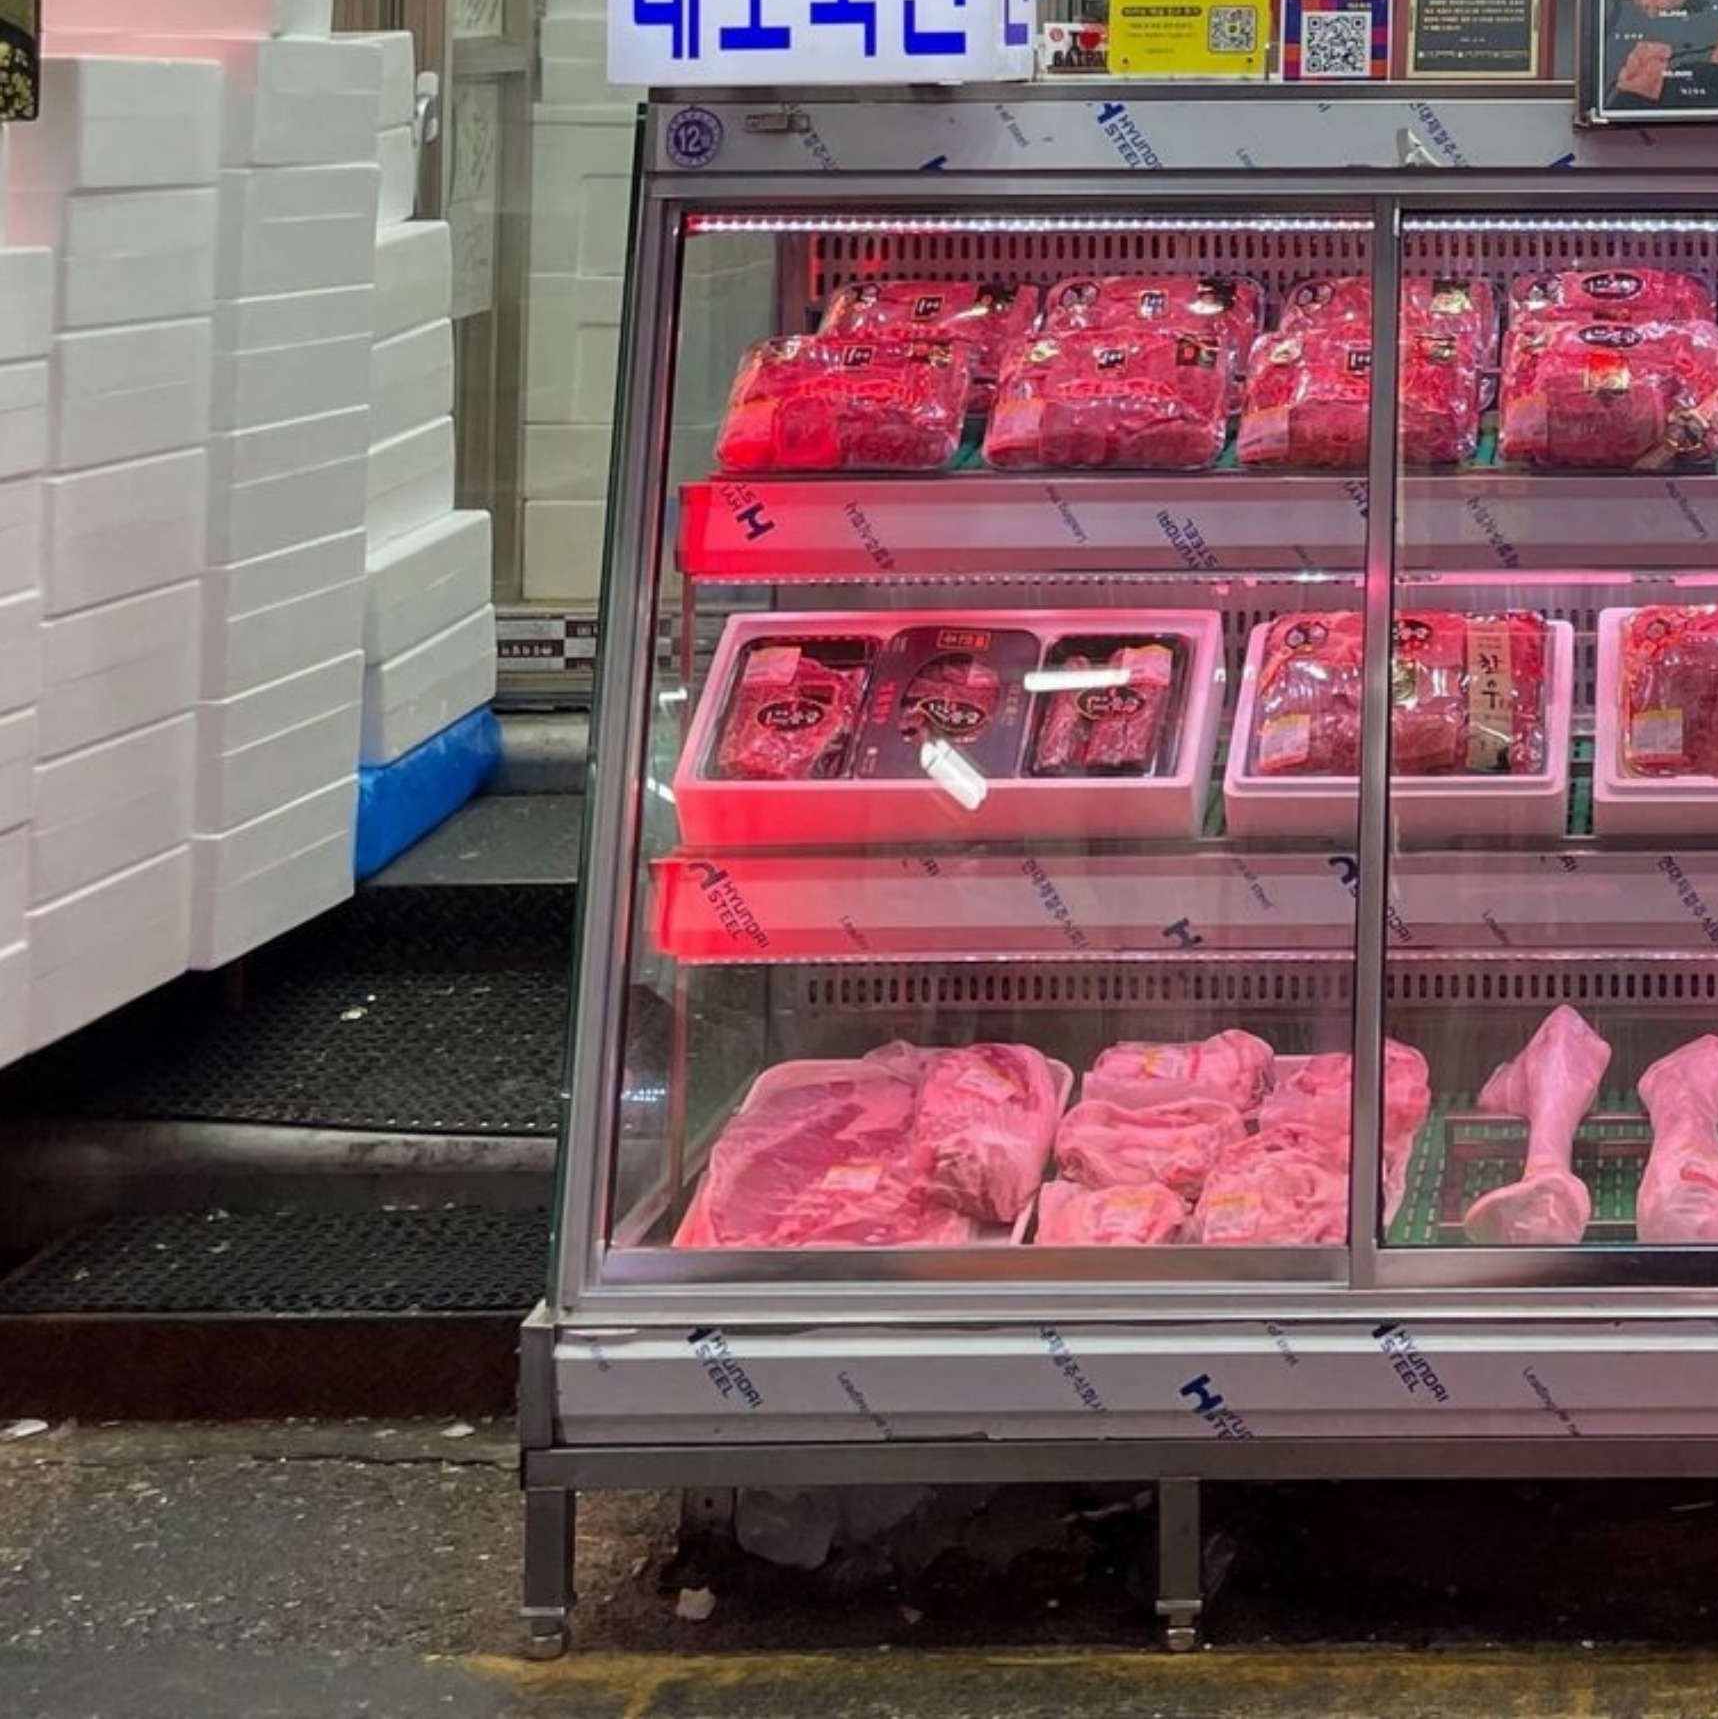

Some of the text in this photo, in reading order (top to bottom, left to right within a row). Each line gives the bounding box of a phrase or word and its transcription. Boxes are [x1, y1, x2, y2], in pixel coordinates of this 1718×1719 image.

[706, 888, 745, 943] STEEL
[720, 881, 770, 950] HYUNDAI
[696, 1342, 735, 1401] STEEL
[710, 1333, 763, 1408] HYUNDAI
[1379, 1335, 1421, 1396] STEEL
[1392, 1327, 1451, 1404] HYUNDAI
